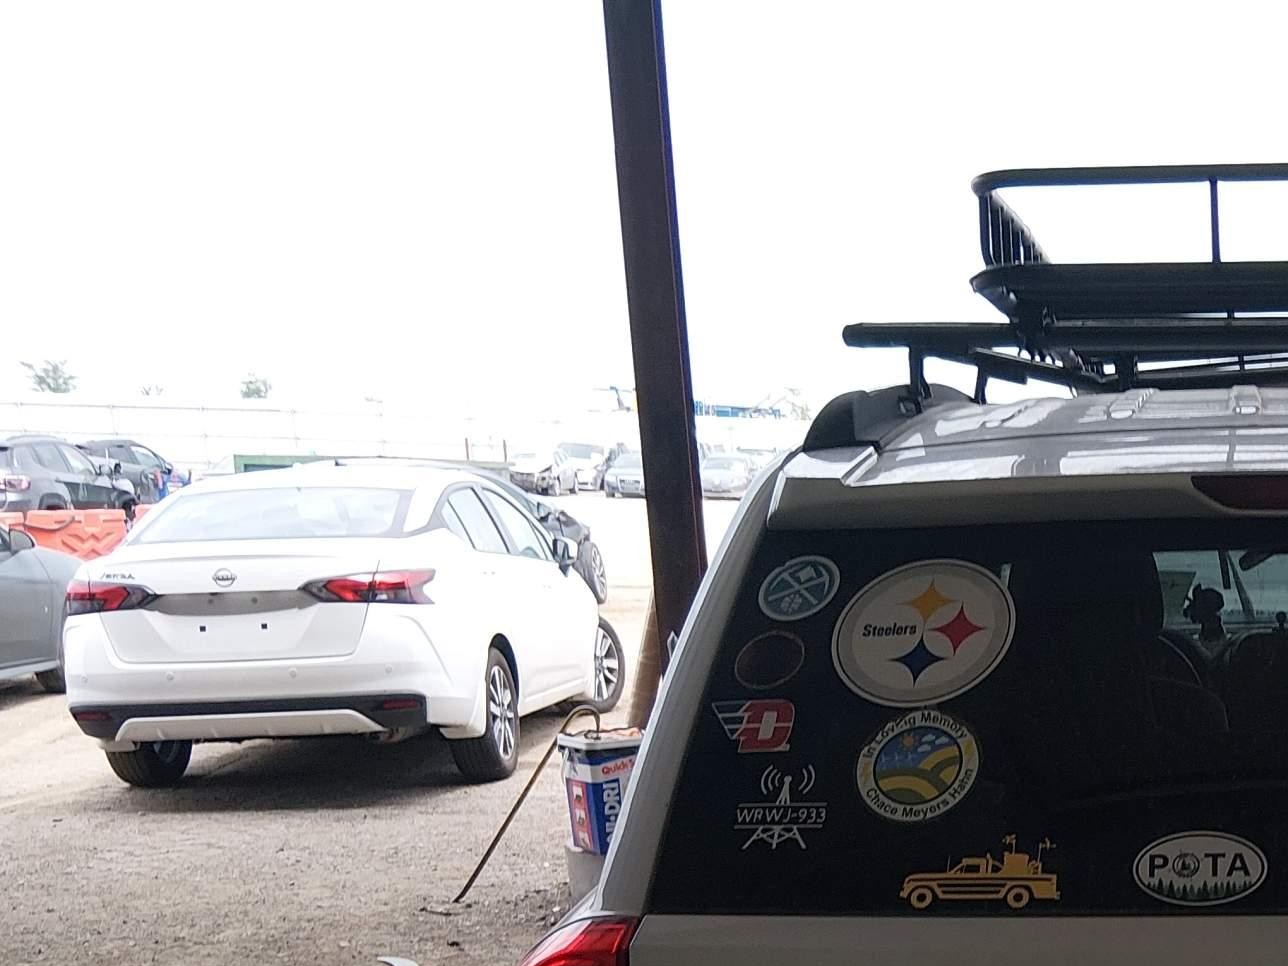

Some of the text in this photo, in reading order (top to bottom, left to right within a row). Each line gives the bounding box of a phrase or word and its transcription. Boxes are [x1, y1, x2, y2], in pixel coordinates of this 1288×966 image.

[862, 622, 917, 638] Steelers
[863, 745, 876, 759] In
[921, 711, 968, 739] Memory
[736, 807, 827, 824] WRWJ-933
[866, 787, 898, 815] Chaco
[902, 799, 949, 820] Meyers
[1148, 850, 1251, 879] POTA
